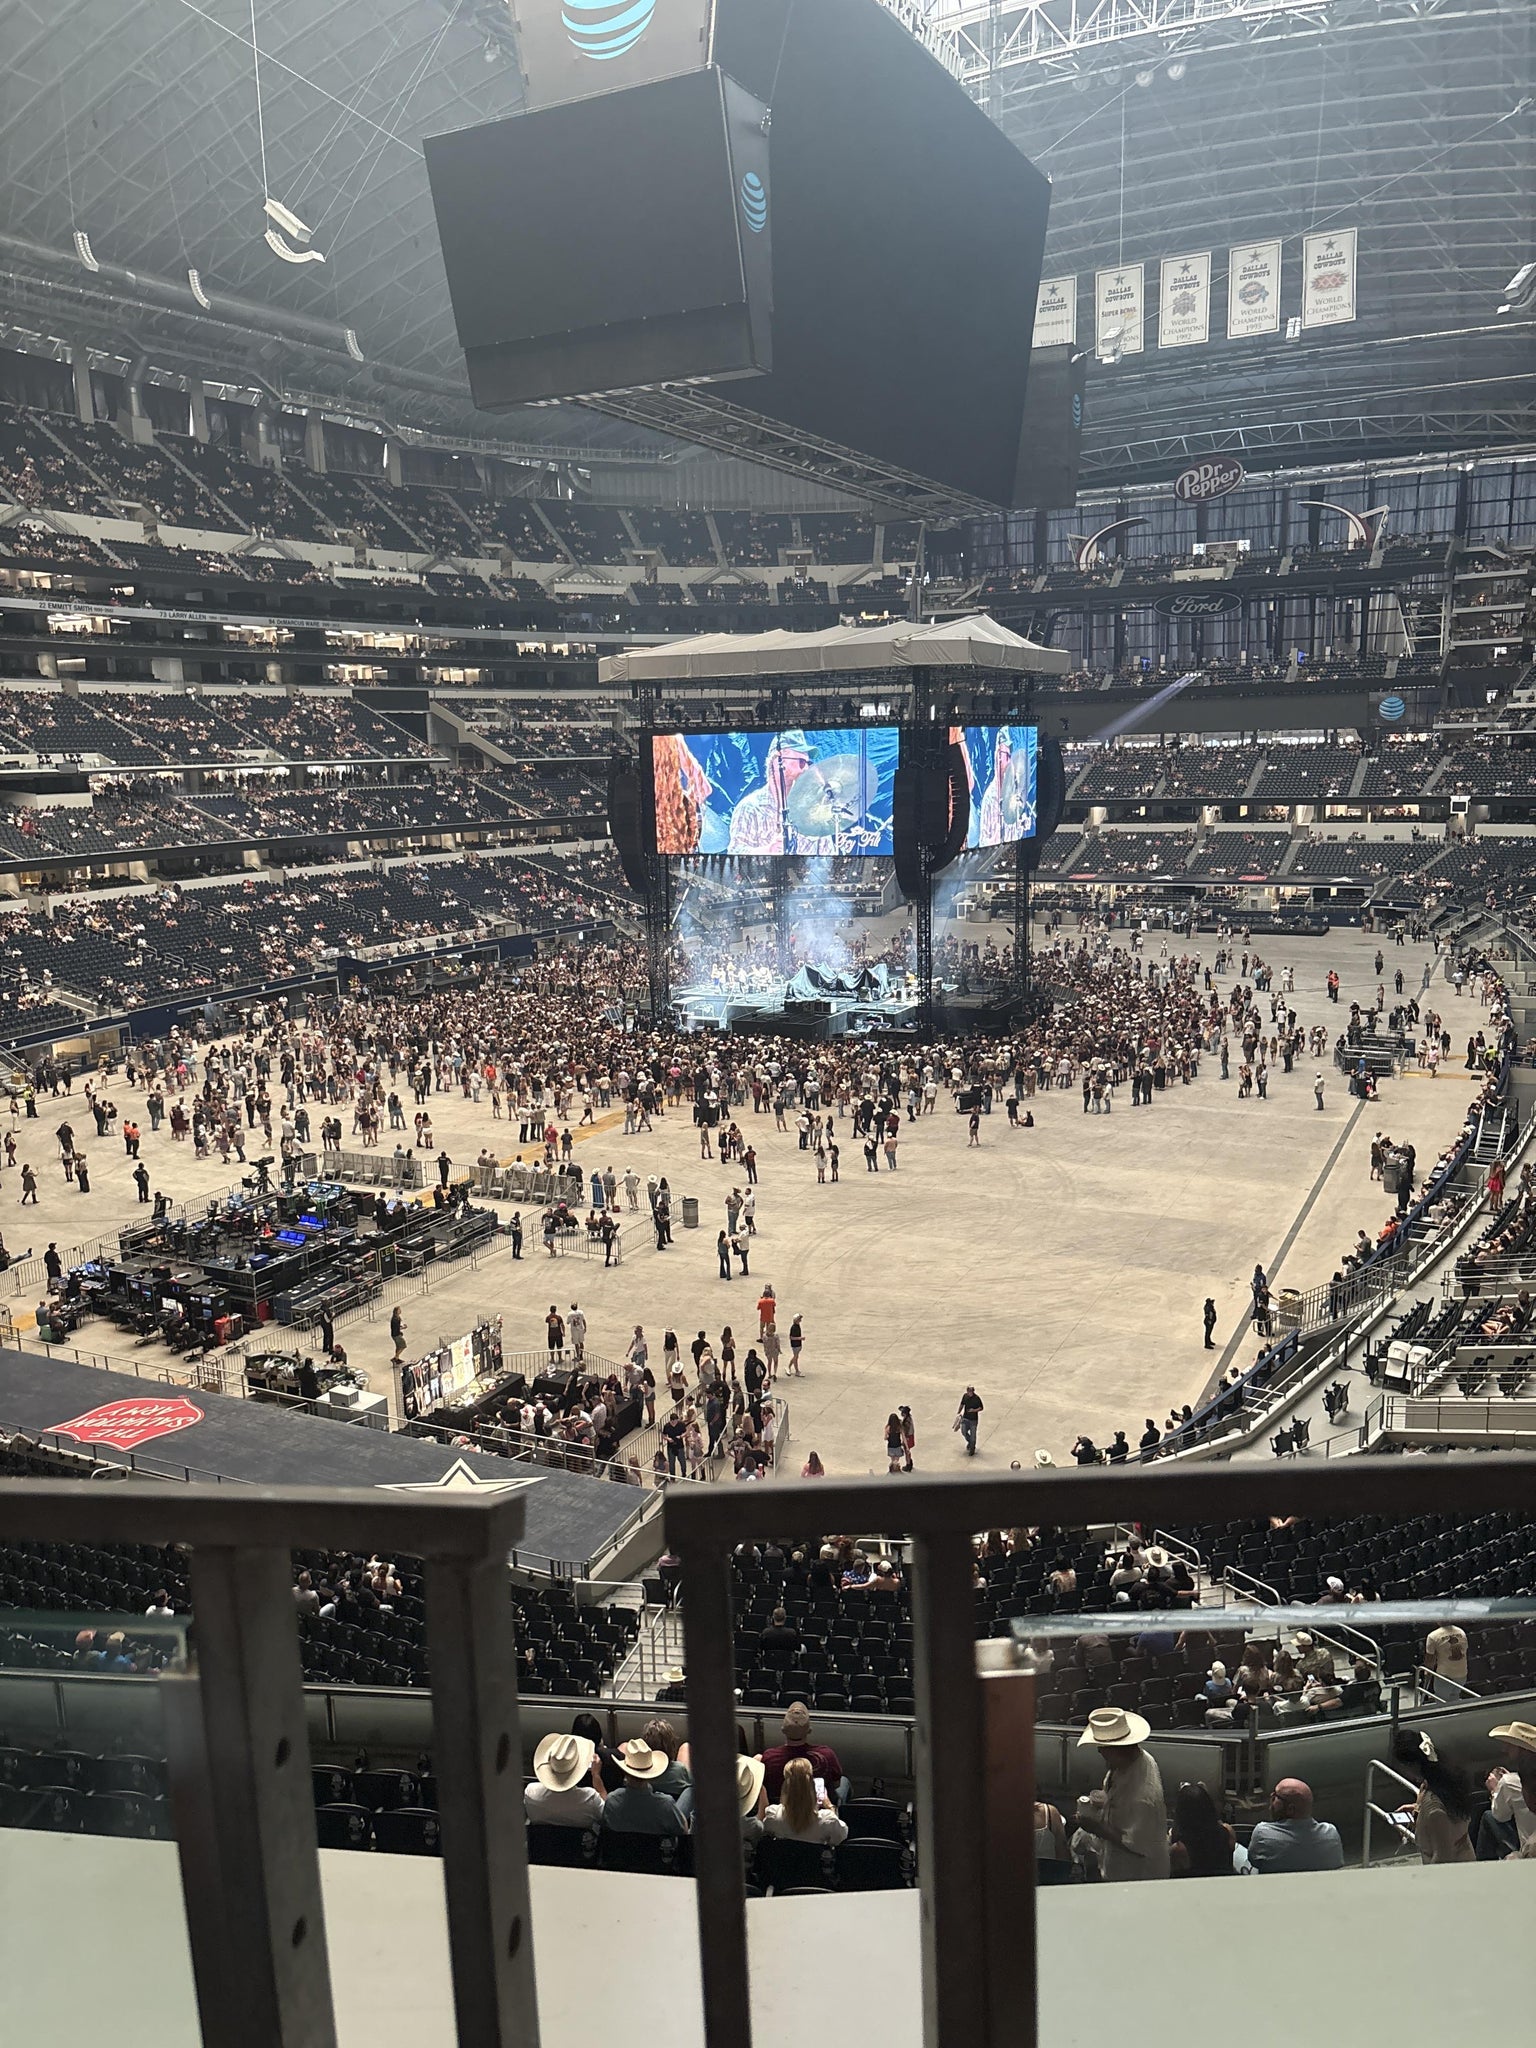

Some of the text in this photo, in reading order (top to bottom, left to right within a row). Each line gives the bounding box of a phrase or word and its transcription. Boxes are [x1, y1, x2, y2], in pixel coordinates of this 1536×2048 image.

[1317, 251, 1343, 262] DALLAS
[1242, 263, 1268, 273] DALLAS
[1314, 258, 1346, 270] COWBOYS
[1173, 274, 1198, 284] DALLAS
[1239, 270, 1271, 281] COWBOYS
[1107, 286, 1132, 296] DALLAS
[1169, 281, 1200, 291] COWBOYS
[1041, 297, 1065, 306] DALLAS
[1104, 292, 1135, 303] COWBOYS
[1315, 296, 1343, 305] WORLD
[1101, 309, 1119, 318] SUPER
[1241, 307, 1268, 316] WORLD
[1307, 303, 1351, 315] CHAMPIONS
[1171, 317, 1197, 326] WORLD
[1232, 313, 1275, 325] CHAMPIONS
[1163, 324, 1205, 335] CHAMPIONS
[1199, 463, 1223, 482] Dr
[1178, 468, 1239, 499] Pepper
[38, 601, 46, 609] 22
[47, 602, 72, 611] EMMITT
[73, 604, 93, 612] SMITH
[1171, 595, 1224, 614] Ford
[168, 611, 188, 619] LARRY
[97, 1404, 186, 1417] ARMY
[63, 1415, 196, 1429] SALVATION
[87, 1428, 147, 1439] THE
